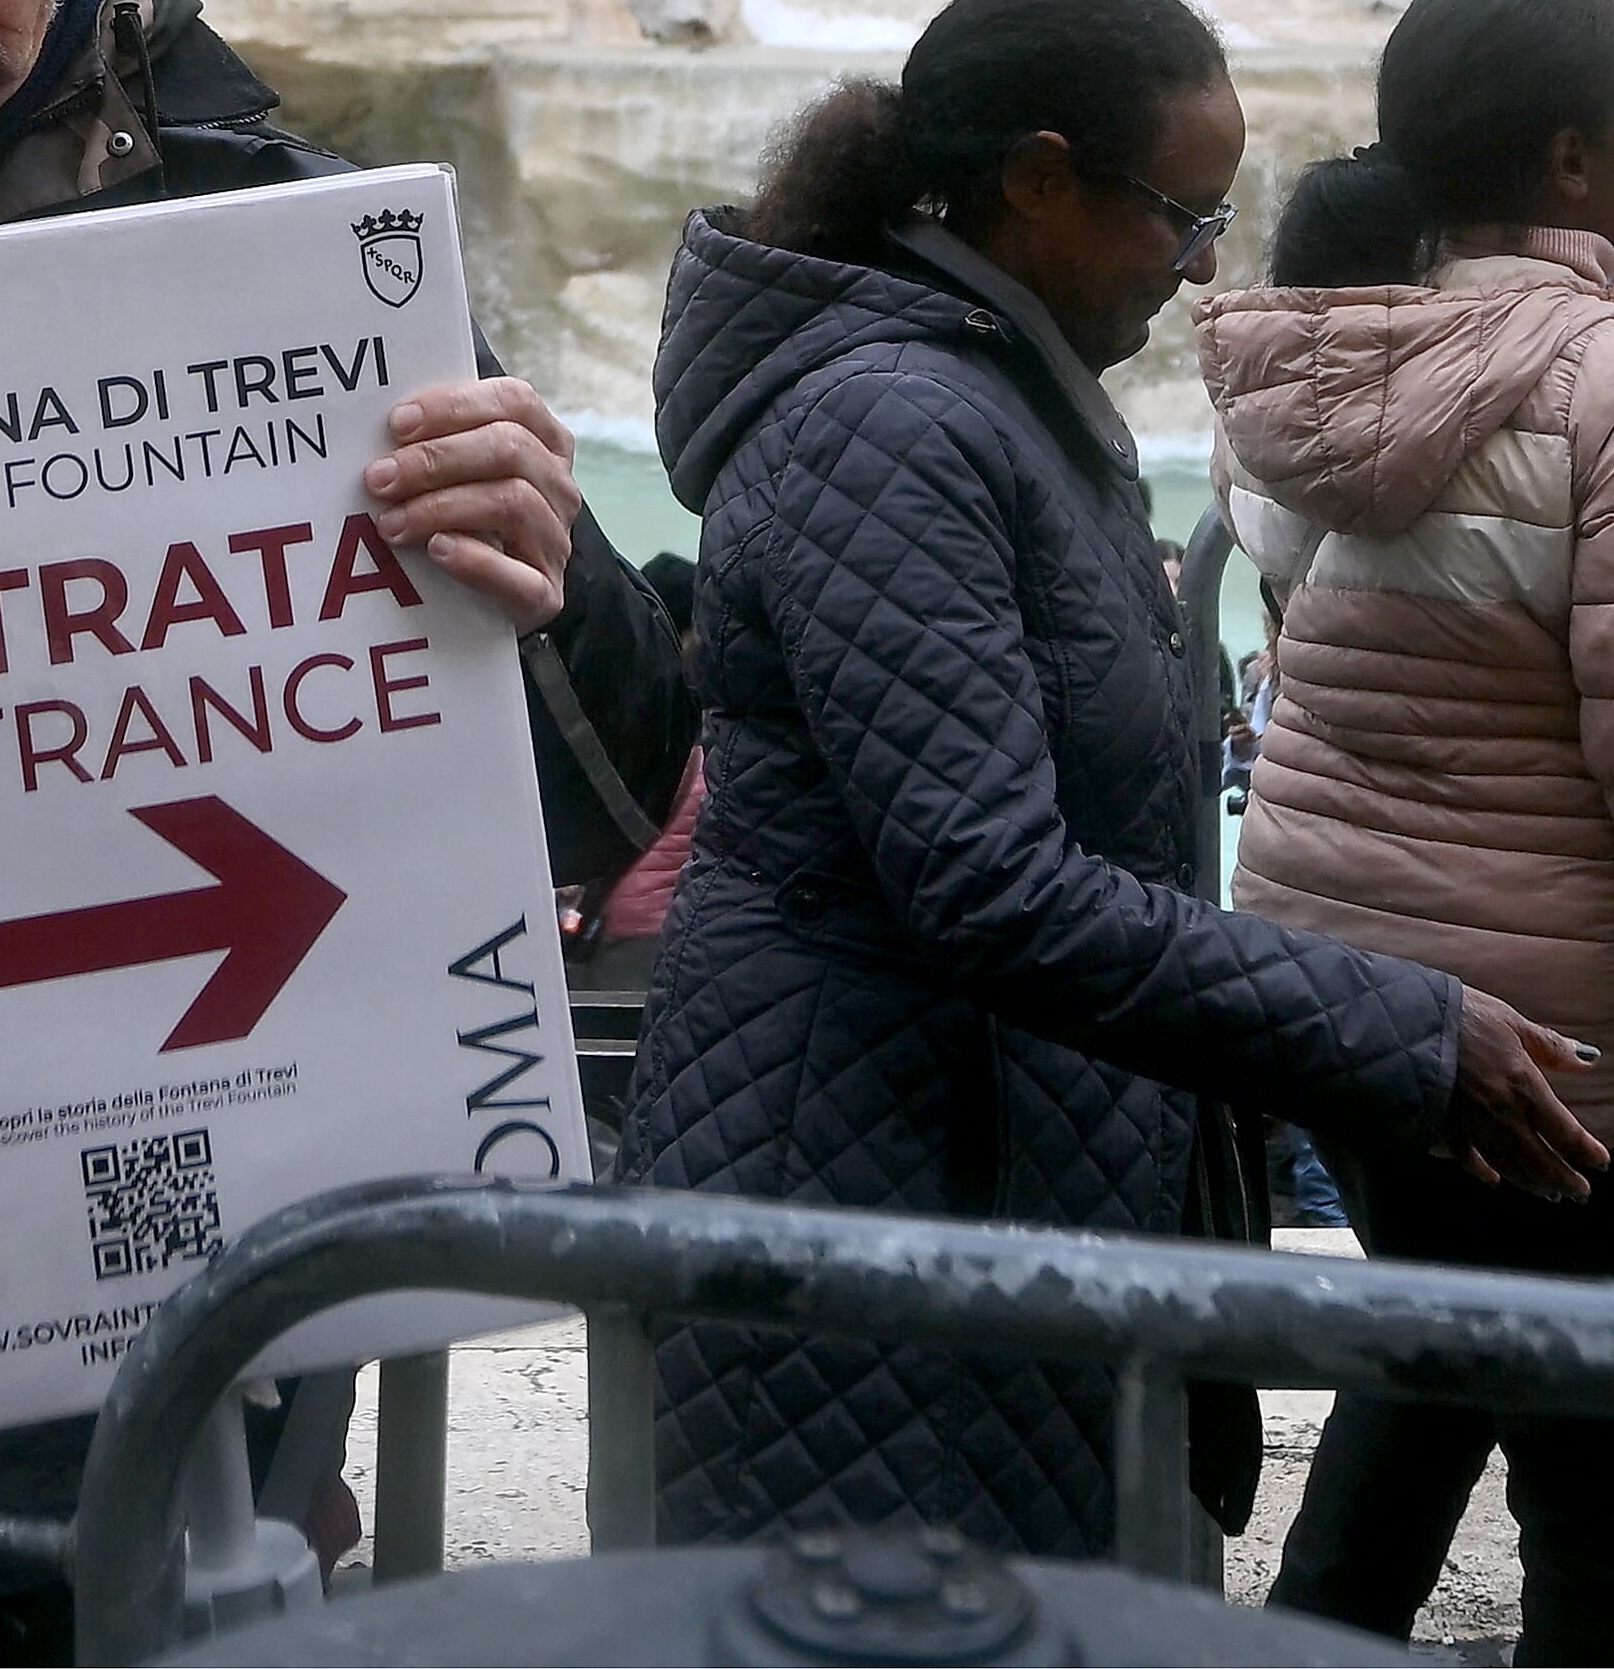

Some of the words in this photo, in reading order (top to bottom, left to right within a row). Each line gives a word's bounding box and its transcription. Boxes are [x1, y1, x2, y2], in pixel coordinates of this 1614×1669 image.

[98, 369, 169, 432] DI
[186, 336, 391, 414] TREVI
[5, 412, 328, 510] FOUNTAIN
[446, 910, 561, 1178] OMA
[38, 1107, 54, 1124] la
[58, 1097, 107, 1121] storia
[112, 1088, 154, 1110] della
[159, 1076, 231, 1103] Fontana
[236, 1068, 252, 1088] di
[255, 1061, 298, 1082] Trevi
[53, 1121, 80, 1137] the
[85, 1112, 136, 1132] history
[140, 1106, 154, 1122] of
[159, 1101, 185, 1119] the
[191, 1094, 224, 1113] Trevi
[228, 1081, 297, 1106] Fountain
